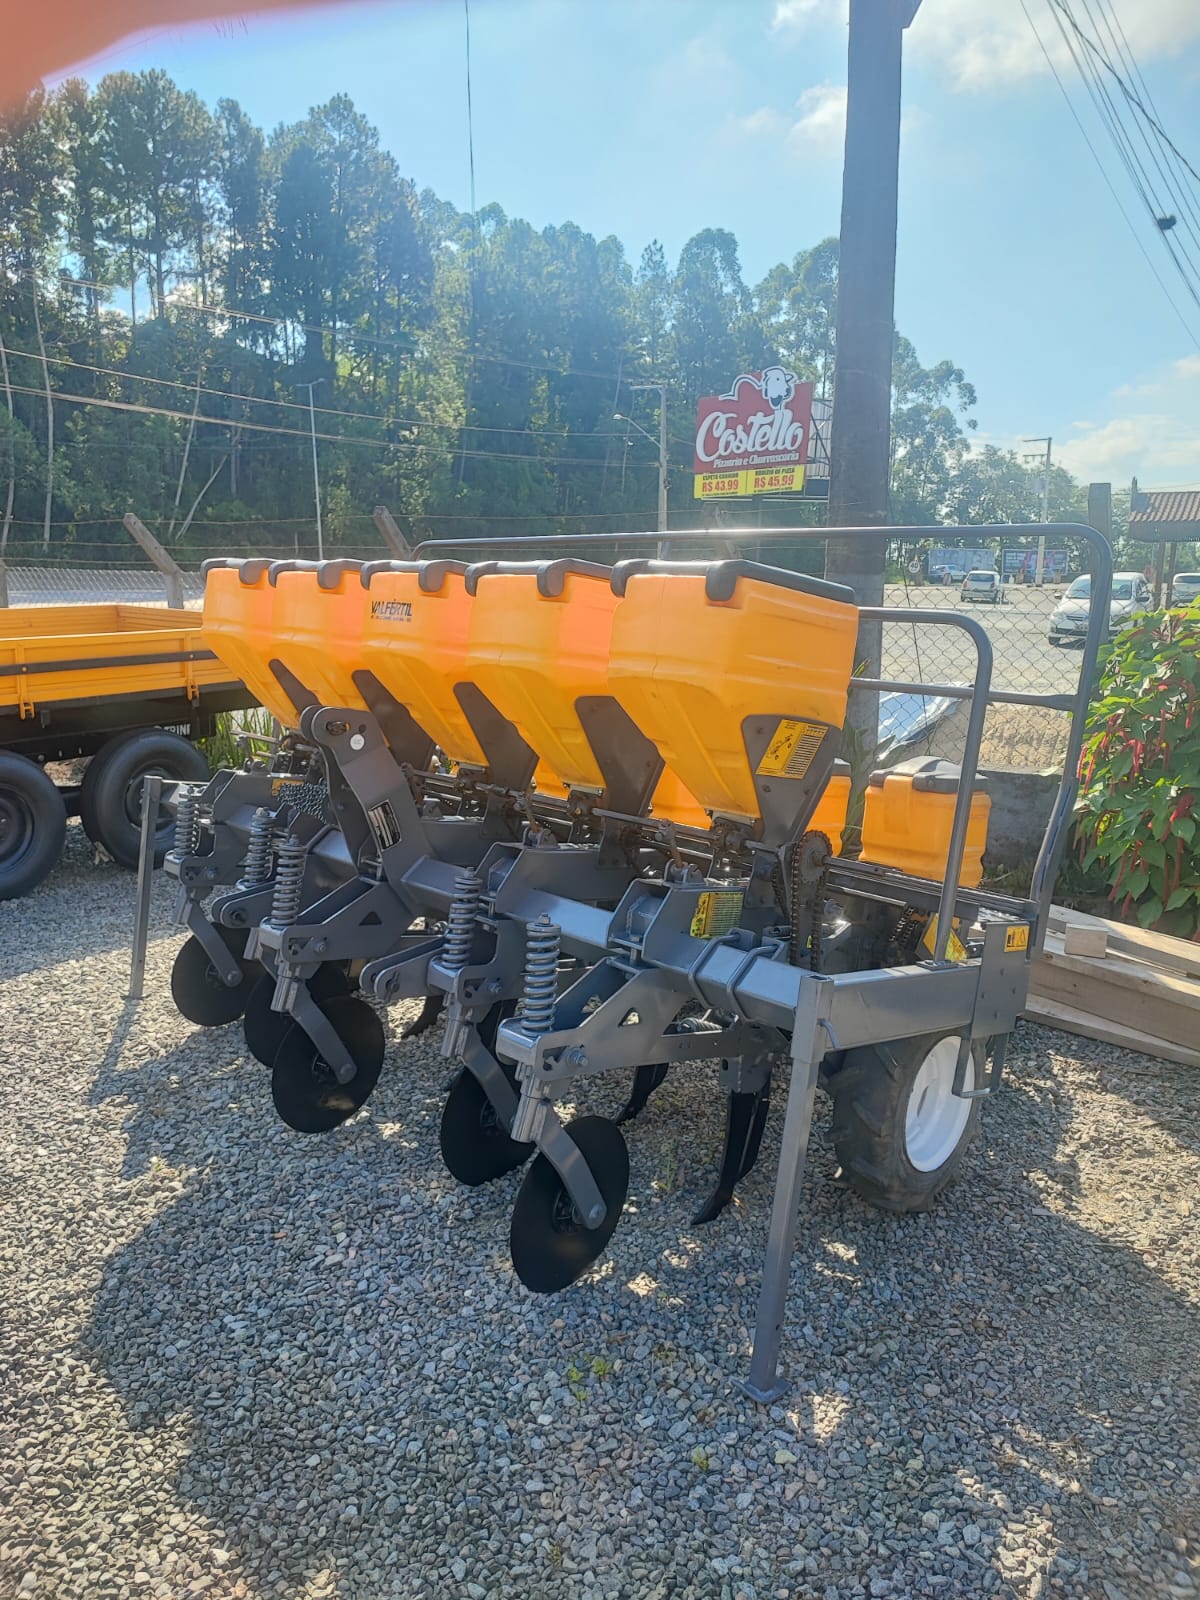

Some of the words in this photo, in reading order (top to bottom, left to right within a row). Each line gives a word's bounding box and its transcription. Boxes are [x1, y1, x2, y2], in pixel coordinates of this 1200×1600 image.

[696, 409, 803, 462] Costello
[702, 481, 713, 493] R$
[754, 476, 766, 489] R$
